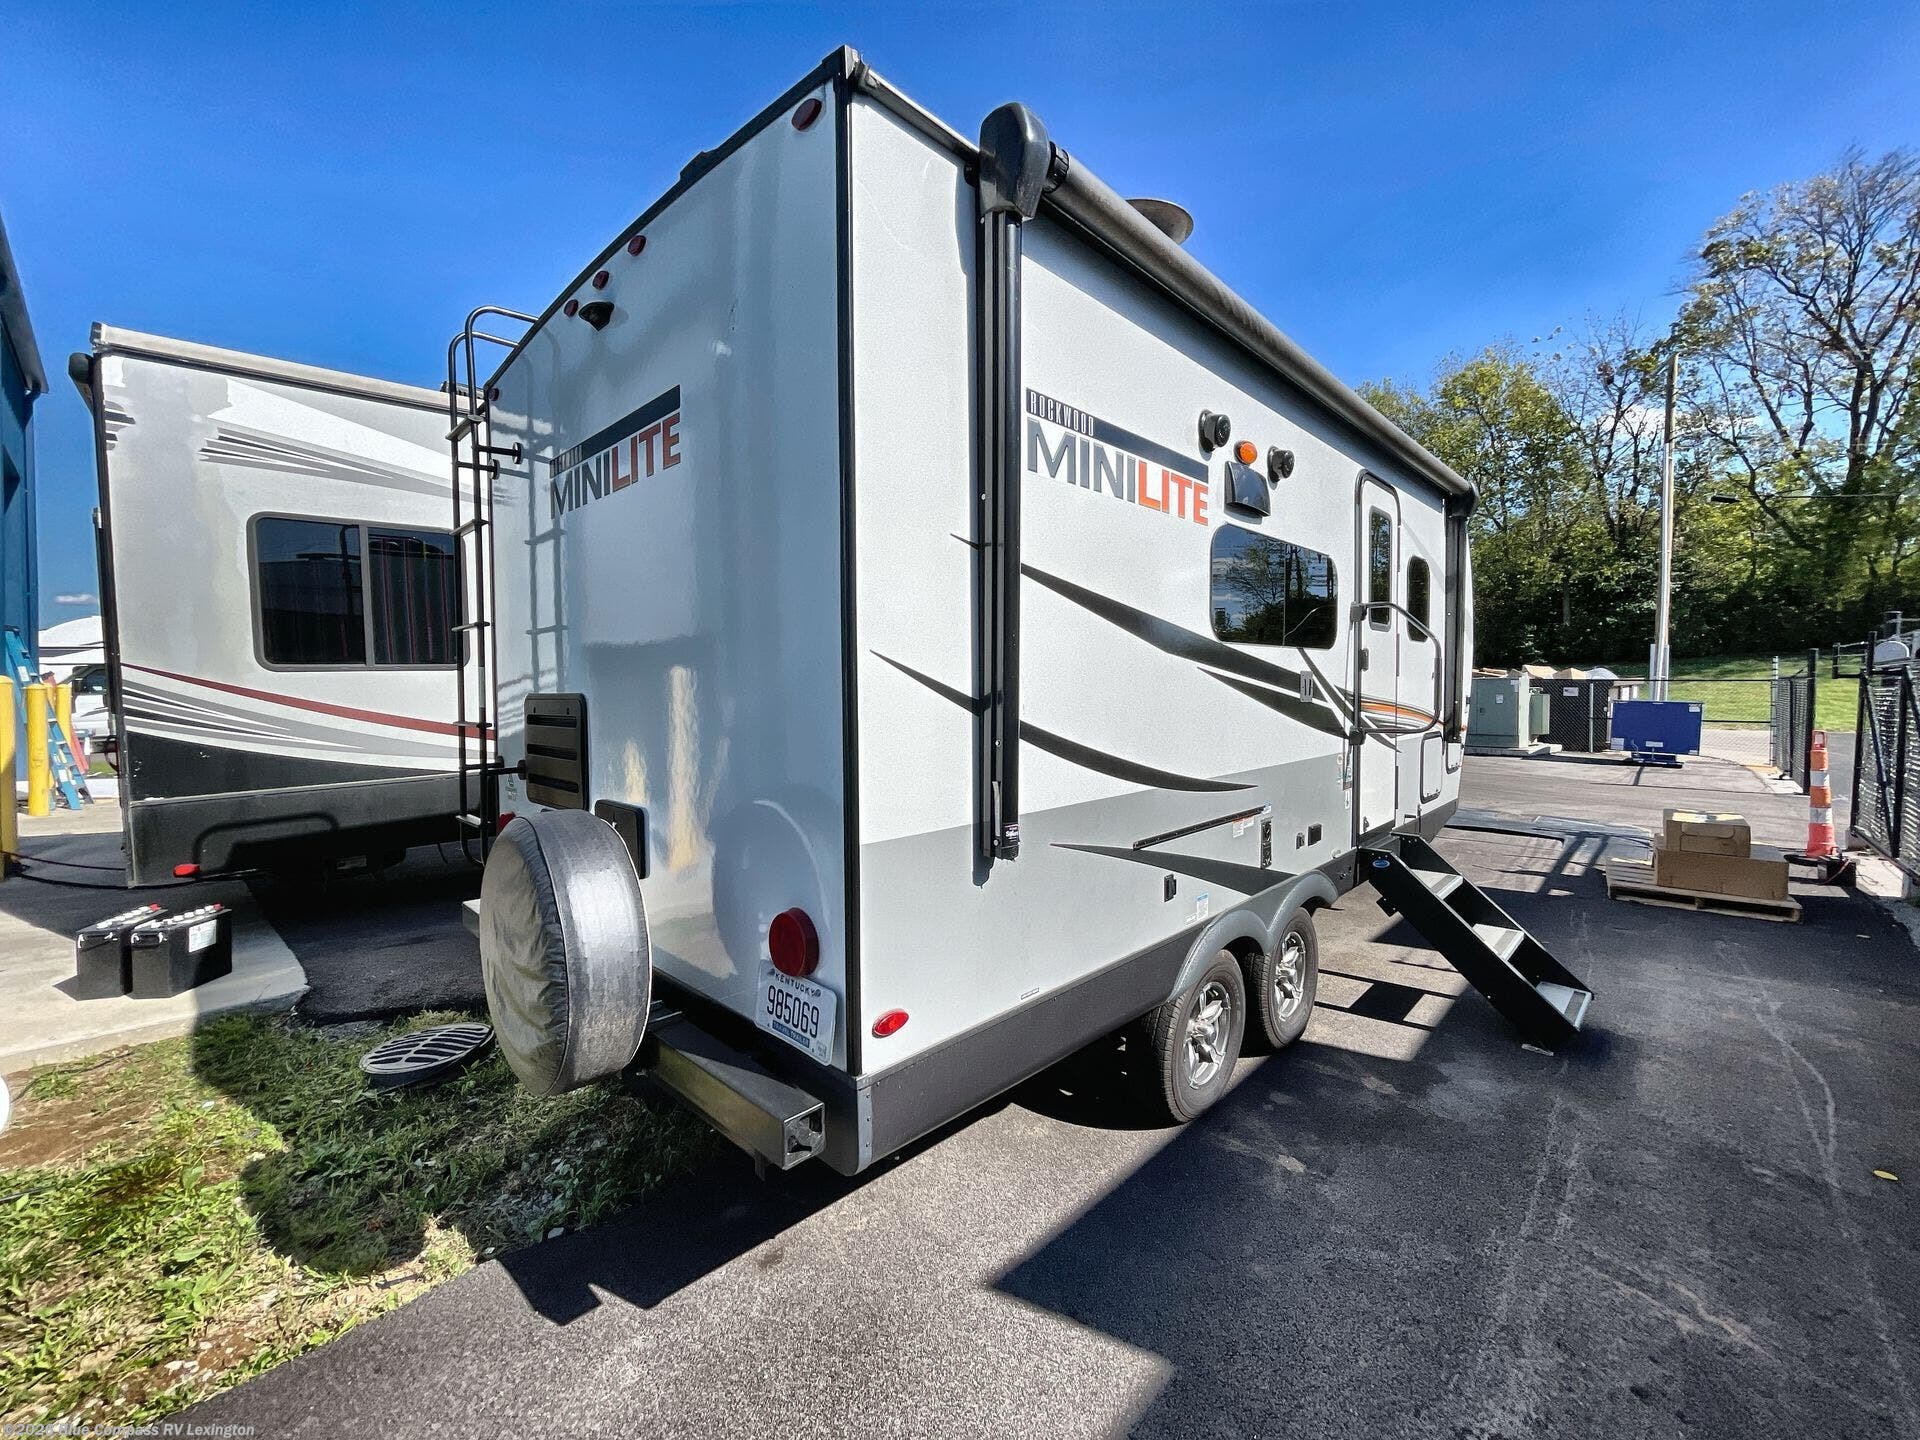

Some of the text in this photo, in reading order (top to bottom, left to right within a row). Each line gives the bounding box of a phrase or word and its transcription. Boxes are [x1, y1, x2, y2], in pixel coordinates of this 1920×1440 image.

[1030, 391, 1094, 437] ROCKWOOD
[775, 973, 815, 997] KENTUCKY
[766, 985, 820, 1039] 985069
